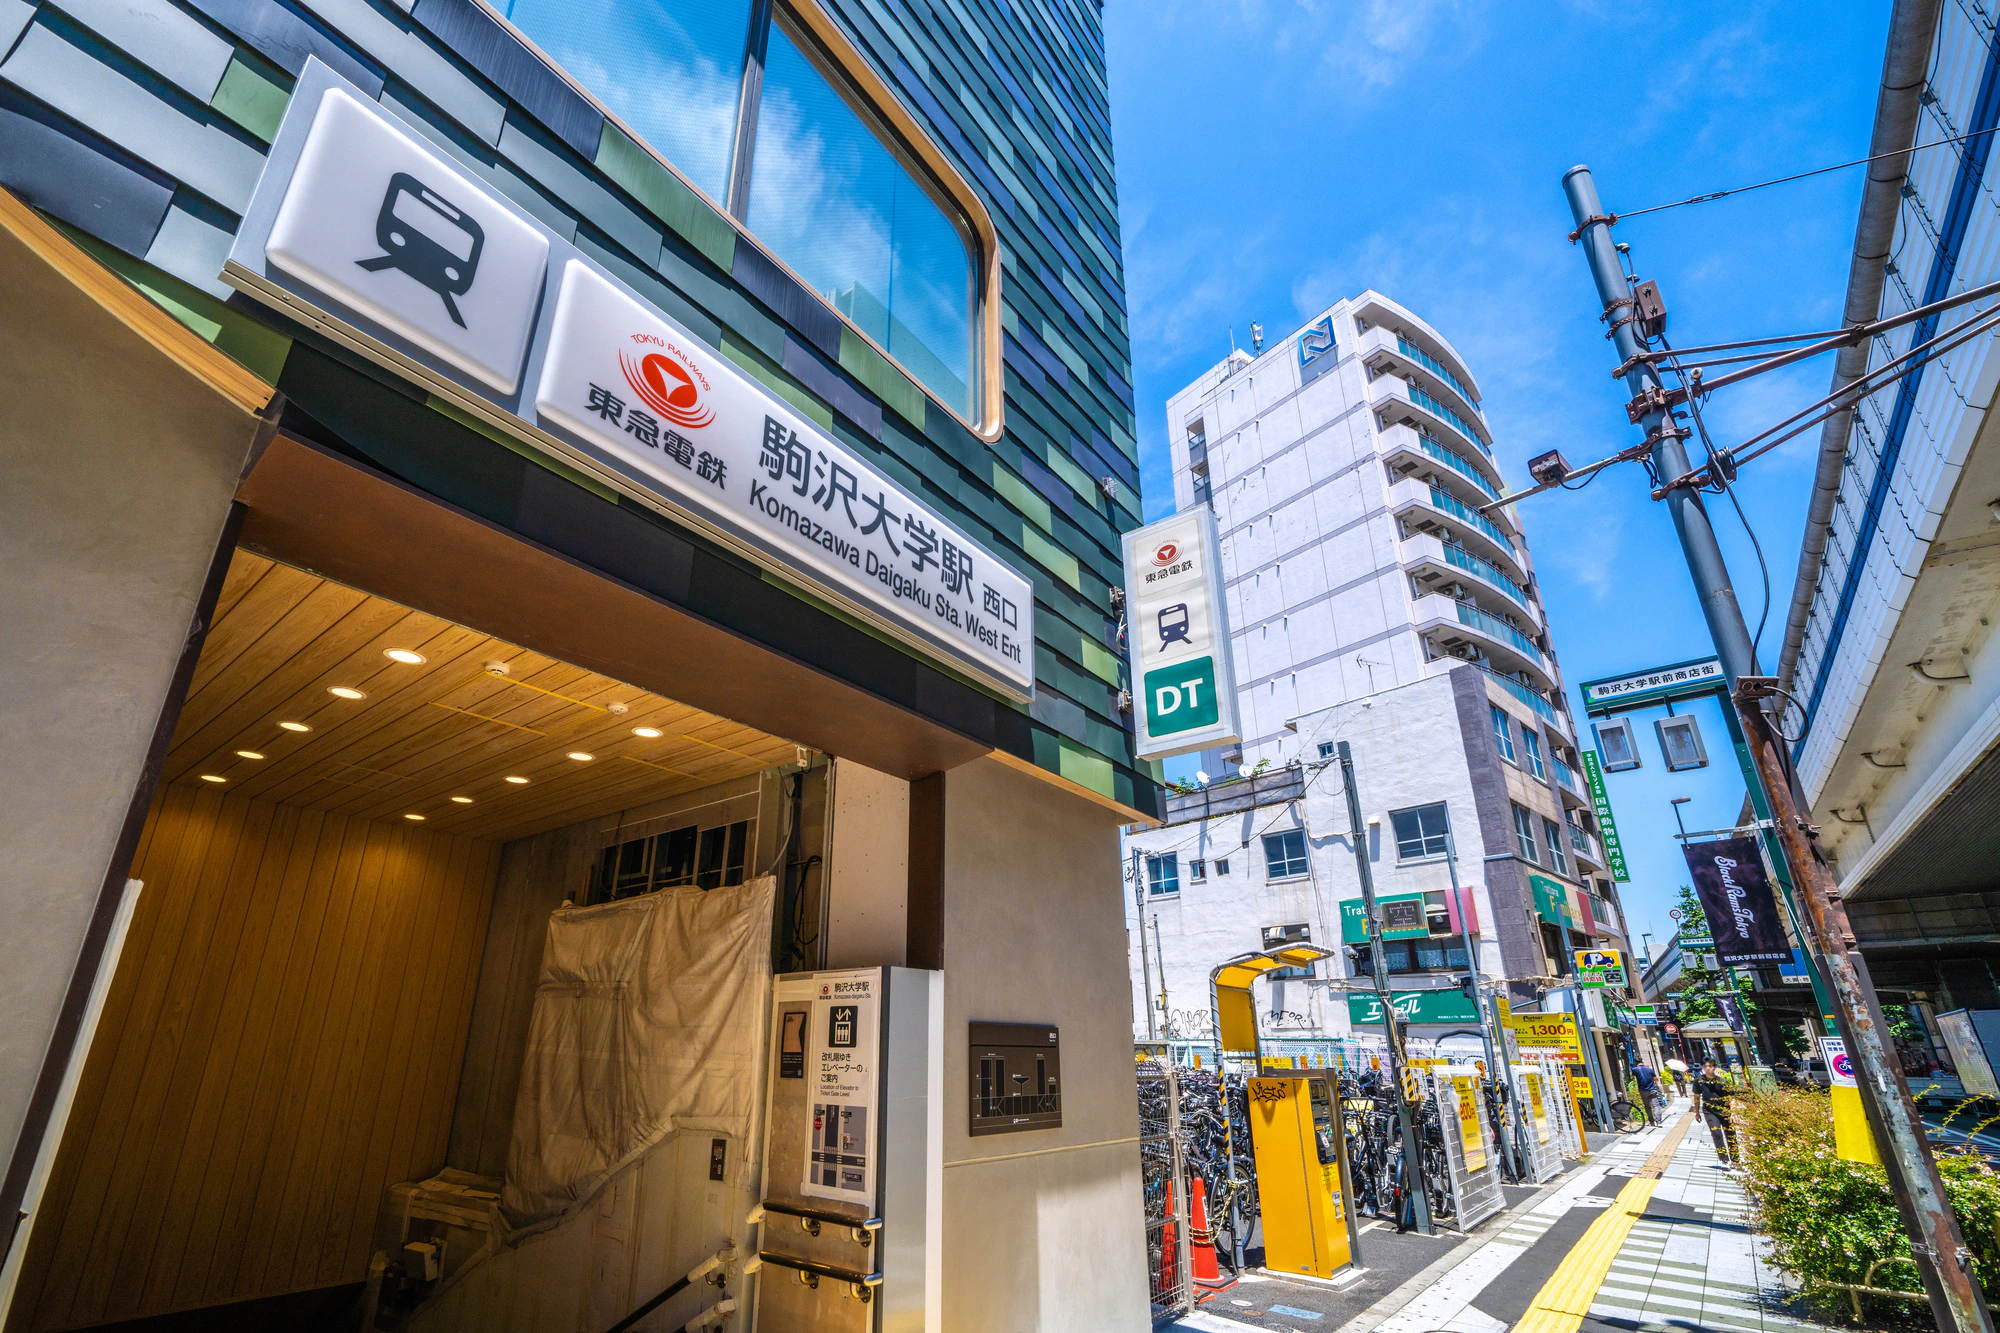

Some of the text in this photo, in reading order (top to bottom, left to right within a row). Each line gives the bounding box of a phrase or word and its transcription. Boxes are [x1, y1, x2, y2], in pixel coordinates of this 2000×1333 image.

[630, 333, 711, 392] TOKYU RAILWAYS
[584, 381, 728, 490] 東急電鉄
[759, 414, 1018, 631] 駒沢大学駅 西口
[749, 478, 1021, 664] Komazawa Daigaku Sta. West Ent
[1145, 560, 1193, 584] 東急電鉄
[1156, 678, 1203, 716] DT
[1597, 664, 1715, 696] 駒沢大学駅前商店街
[1595, 796, 1626, 878] 国際動物専門学校
[835, 981, 870, 993] 駒沢大学駅
[1530, 1024, 1574, 1036] 1,300円
[820, 1073, 839, 1083] ご案内
[821, 1063, 863, 1072] エレベーターの
